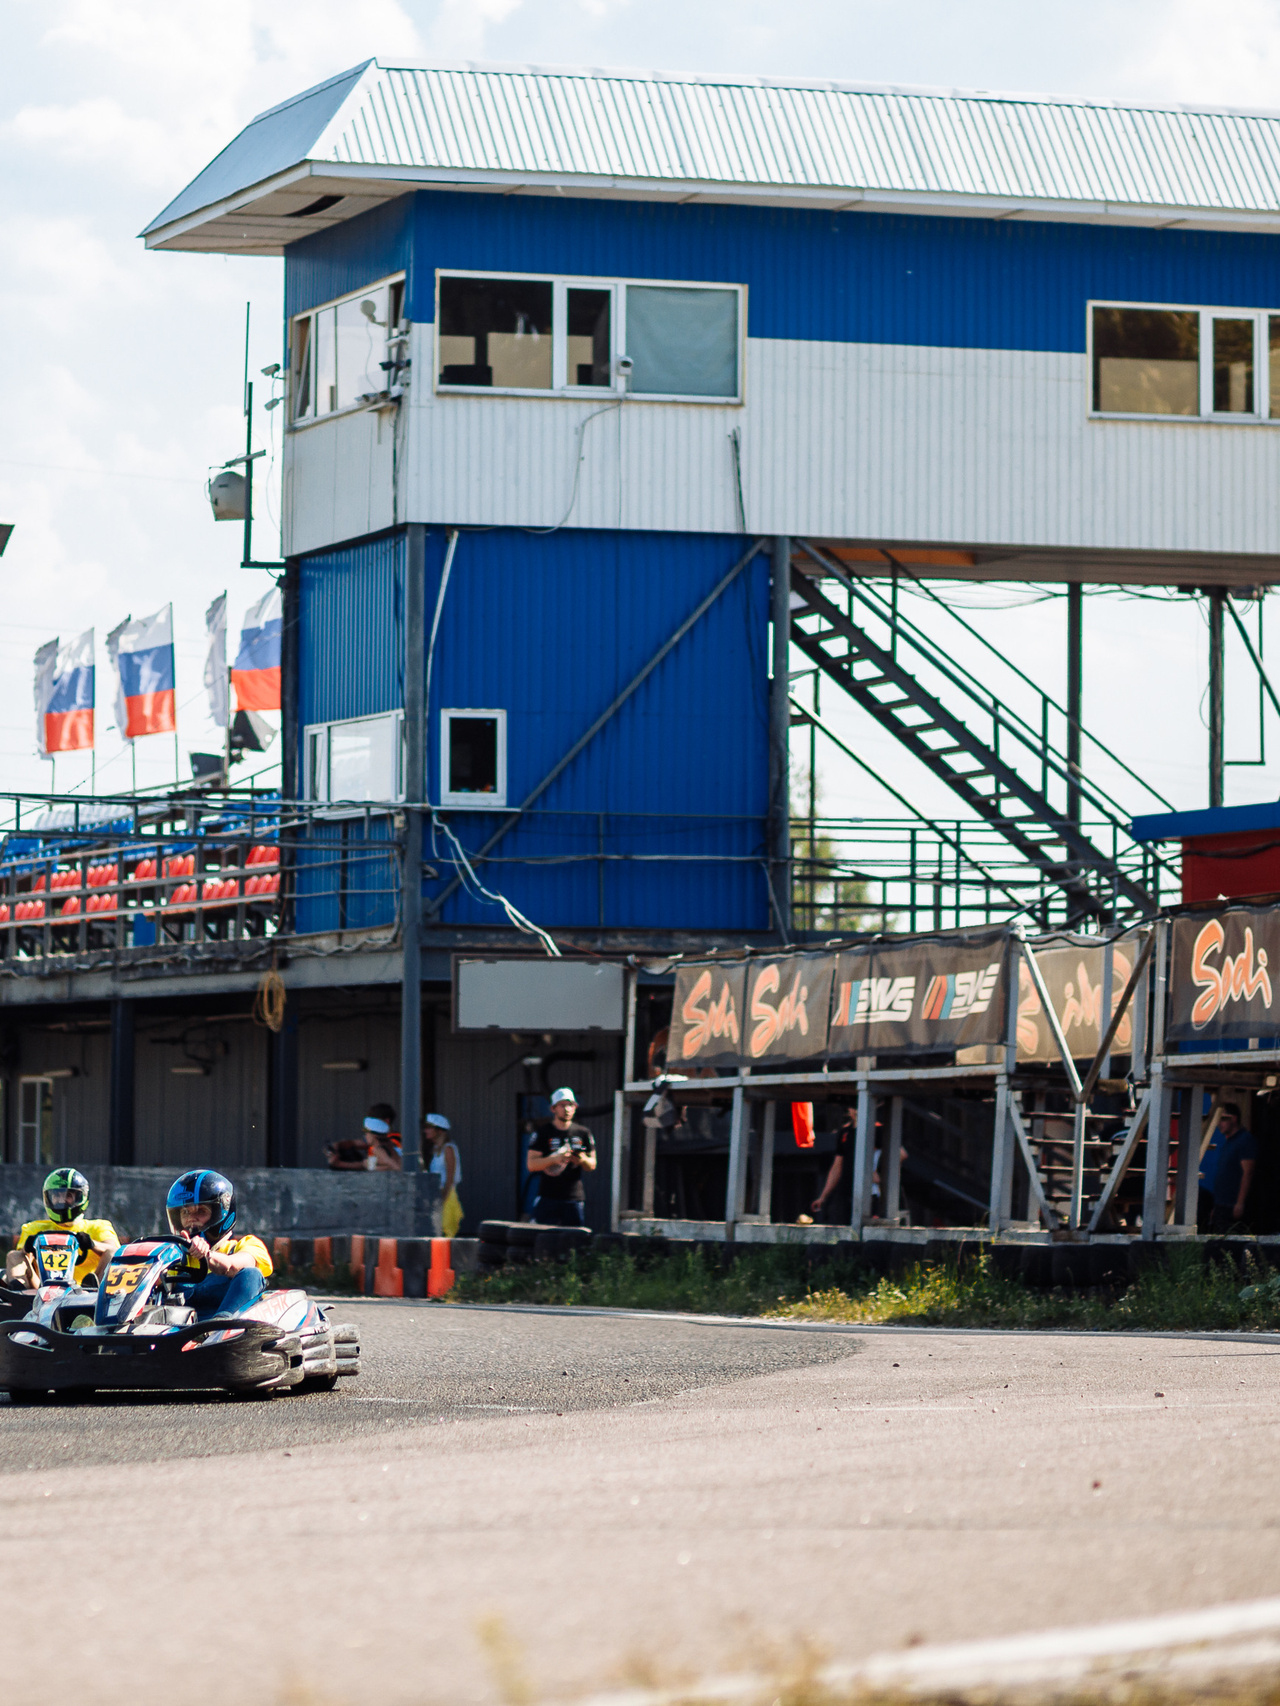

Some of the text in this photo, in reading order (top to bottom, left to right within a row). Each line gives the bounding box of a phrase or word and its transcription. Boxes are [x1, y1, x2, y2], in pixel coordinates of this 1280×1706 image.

[1192, 919, 1272, 1030] Sodi
[45, 1254, 68, 1268] 42
[106, 1267, 148, 1287] 33
